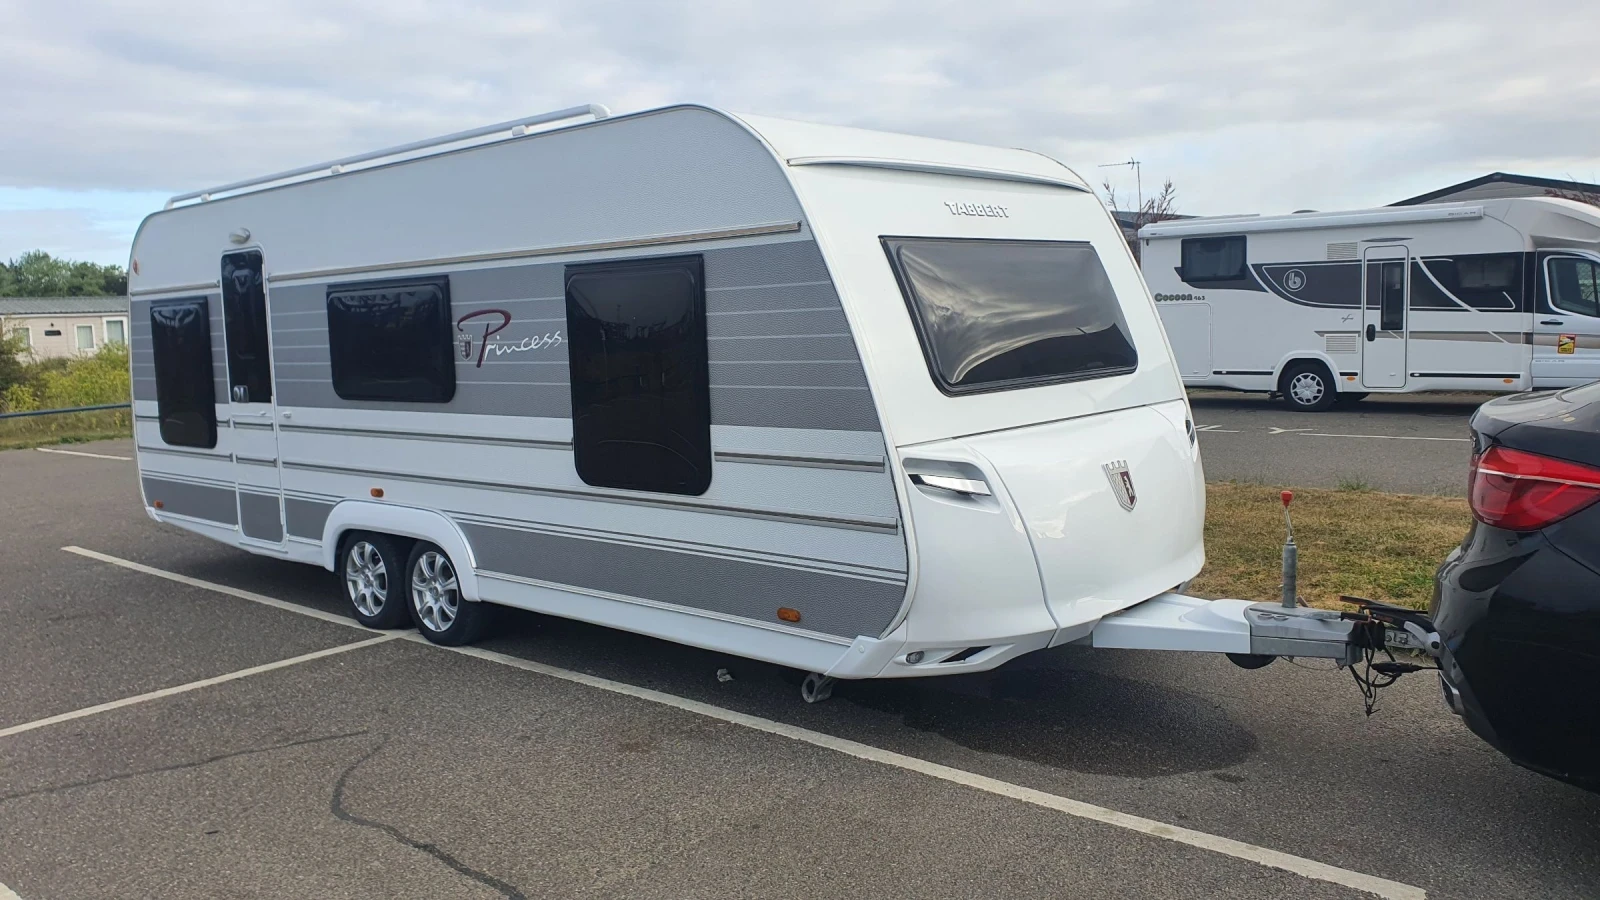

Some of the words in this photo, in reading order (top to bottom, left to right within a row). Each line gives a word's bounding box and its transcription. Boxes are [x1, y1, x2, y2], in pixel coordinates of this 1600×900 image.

[944, 201, 1009, 218] TABBERT
[1154, 292, 1193, 302] Cocoon
[457, 308, 563, 368] Princess
